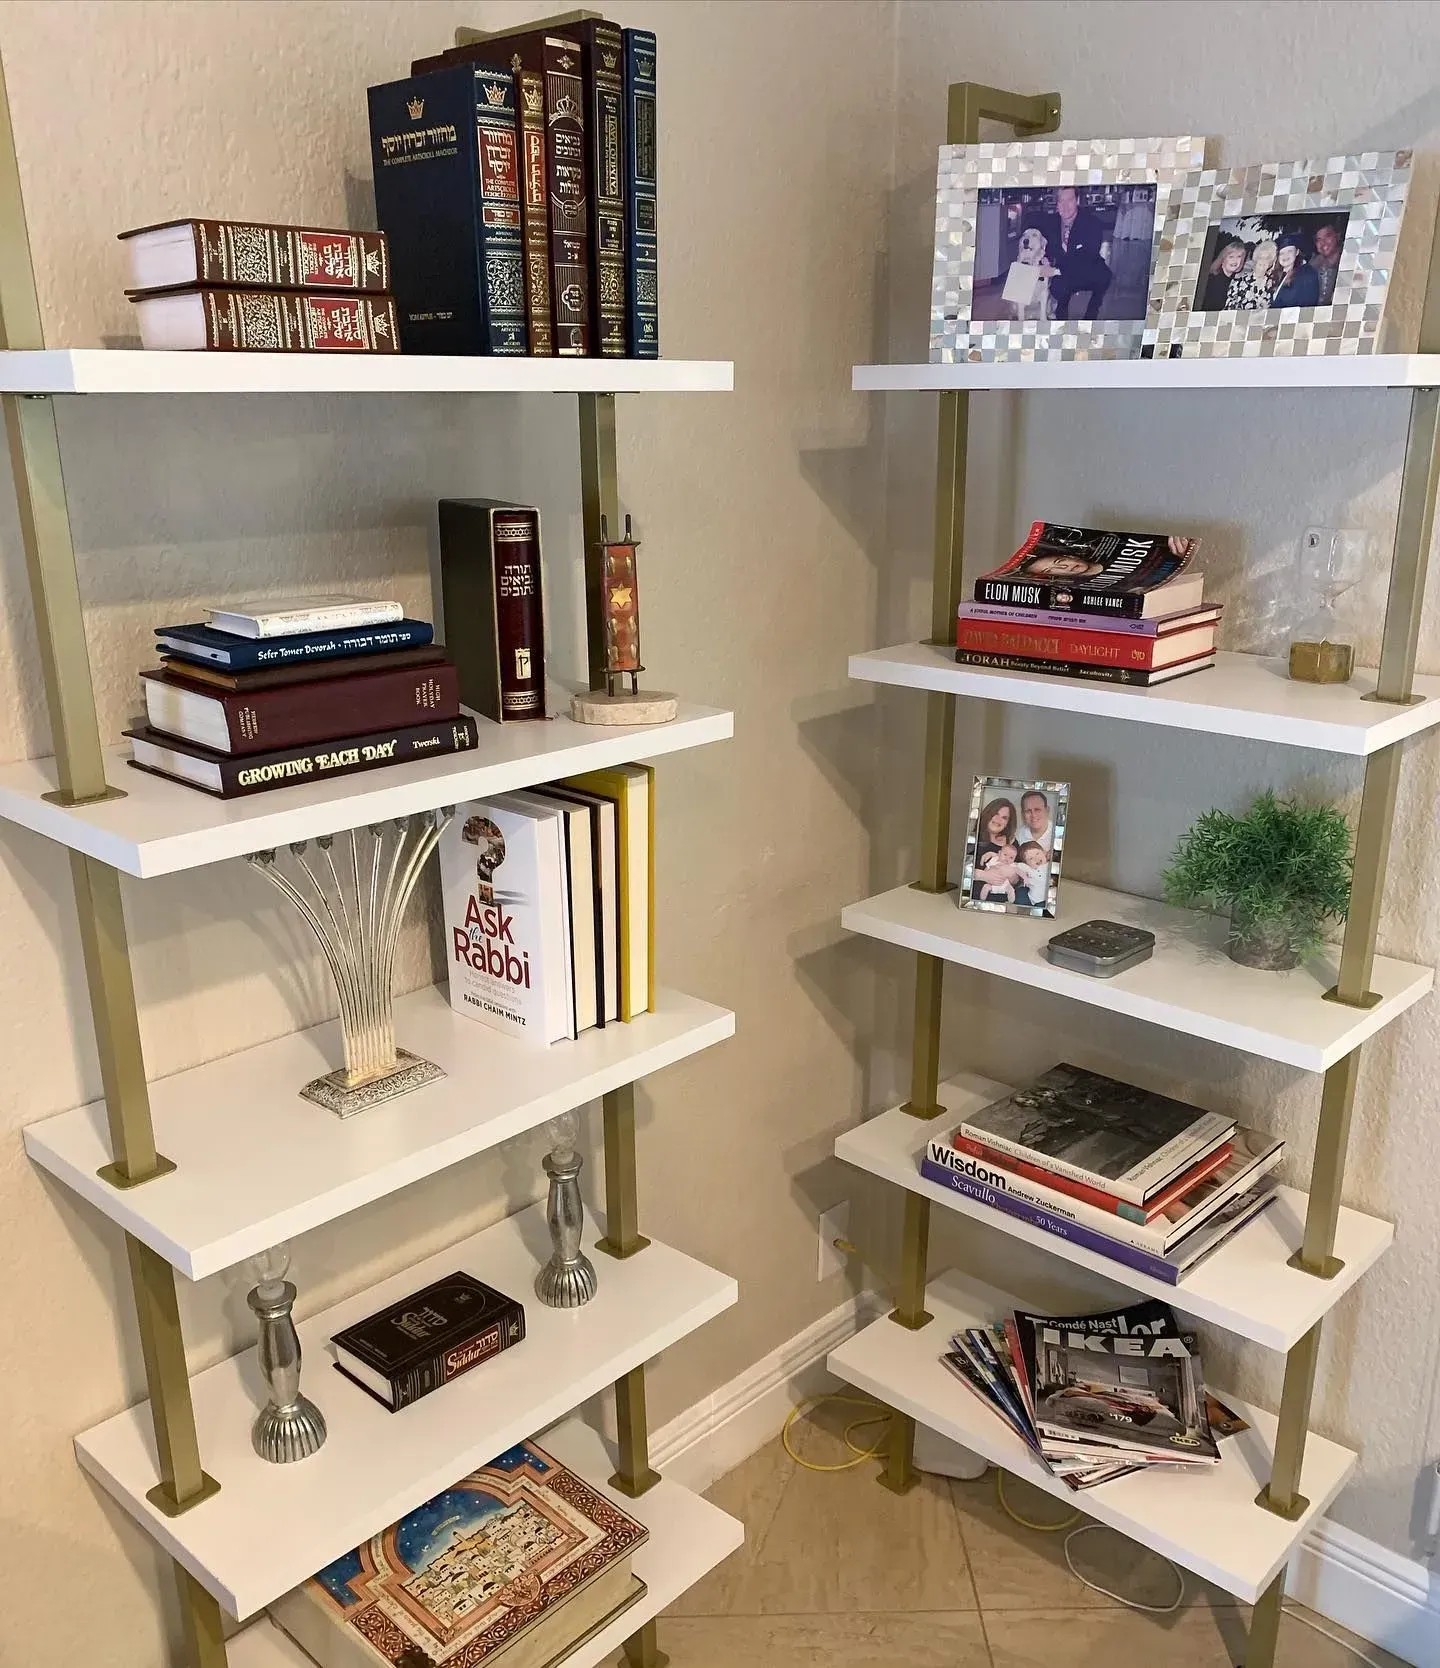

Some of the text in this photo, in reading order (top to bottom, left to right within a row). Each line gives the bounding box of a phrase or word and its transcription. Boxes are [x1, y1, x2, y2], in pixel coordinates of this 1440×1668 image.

[381, 125, 457, 157] מחזור זכרון יוסף
[481, 128, 513, 145] מחזור
[1105, 538, 1154, 574] MUSK
[504, 564, 531, 575] תורה
[985, 582, 1041, 605] ELON MUSK
[1083, 595, 1124, 608] ASHLEE VANCE
[343, 636, 373, 649] דבורה
[374, 633, 399, 645] תומר
[258, 641, 336, 661] Sefer Tomer Devorah
[964, 653, 1009, 668] TORAH
[1070, 643, 1121, 659] DAYLIGHT
[428, 678, 436, 709] HOLYDAY
[412, 736, 441, 749] Twerski
[237, 739, 398, 787] GROWING EACH DAY
[464, 895, 515, 945] Ask
[468, 927, 482, 942] the
[453, 927, 530, 989] Rabbi
[463, 993, 483, 1008] RABBI
[483, 1002, 505, 1017] CHAIM
[505, 1011, 527, 1026] MINTZ
[965, 1128, 987, 1144] Roman
[987, 1136, 1012, 1153] Vishniac
[1013, 1148, 1041, 1164] Children
[1041, 1158, 1050, 1167] of
[1055, 1163, 1084, 1181] Vanished
[1084, 1174, 1107, 1190] World
[931, 1143, 1007, 1190] Wisdom
[1007, 1185, 1034, 1202] Andrew
[1035, 1197, 1076, 1220] Zuckerman
[951, 1175, 996, 1204] Scavullo
[1035, 1215, 1047, 1226] 50
[1047, 1218, 1068, 1236] Years
[1049, 1320, 1087, 1331] Condé
[1088, 1317, 1118, 1331] Nast
[476, 1331, 499, 1348] סדור
[1043, 1327, 1193, 1358] IKEA
[447, 1349, 481, 1376] Siddur
